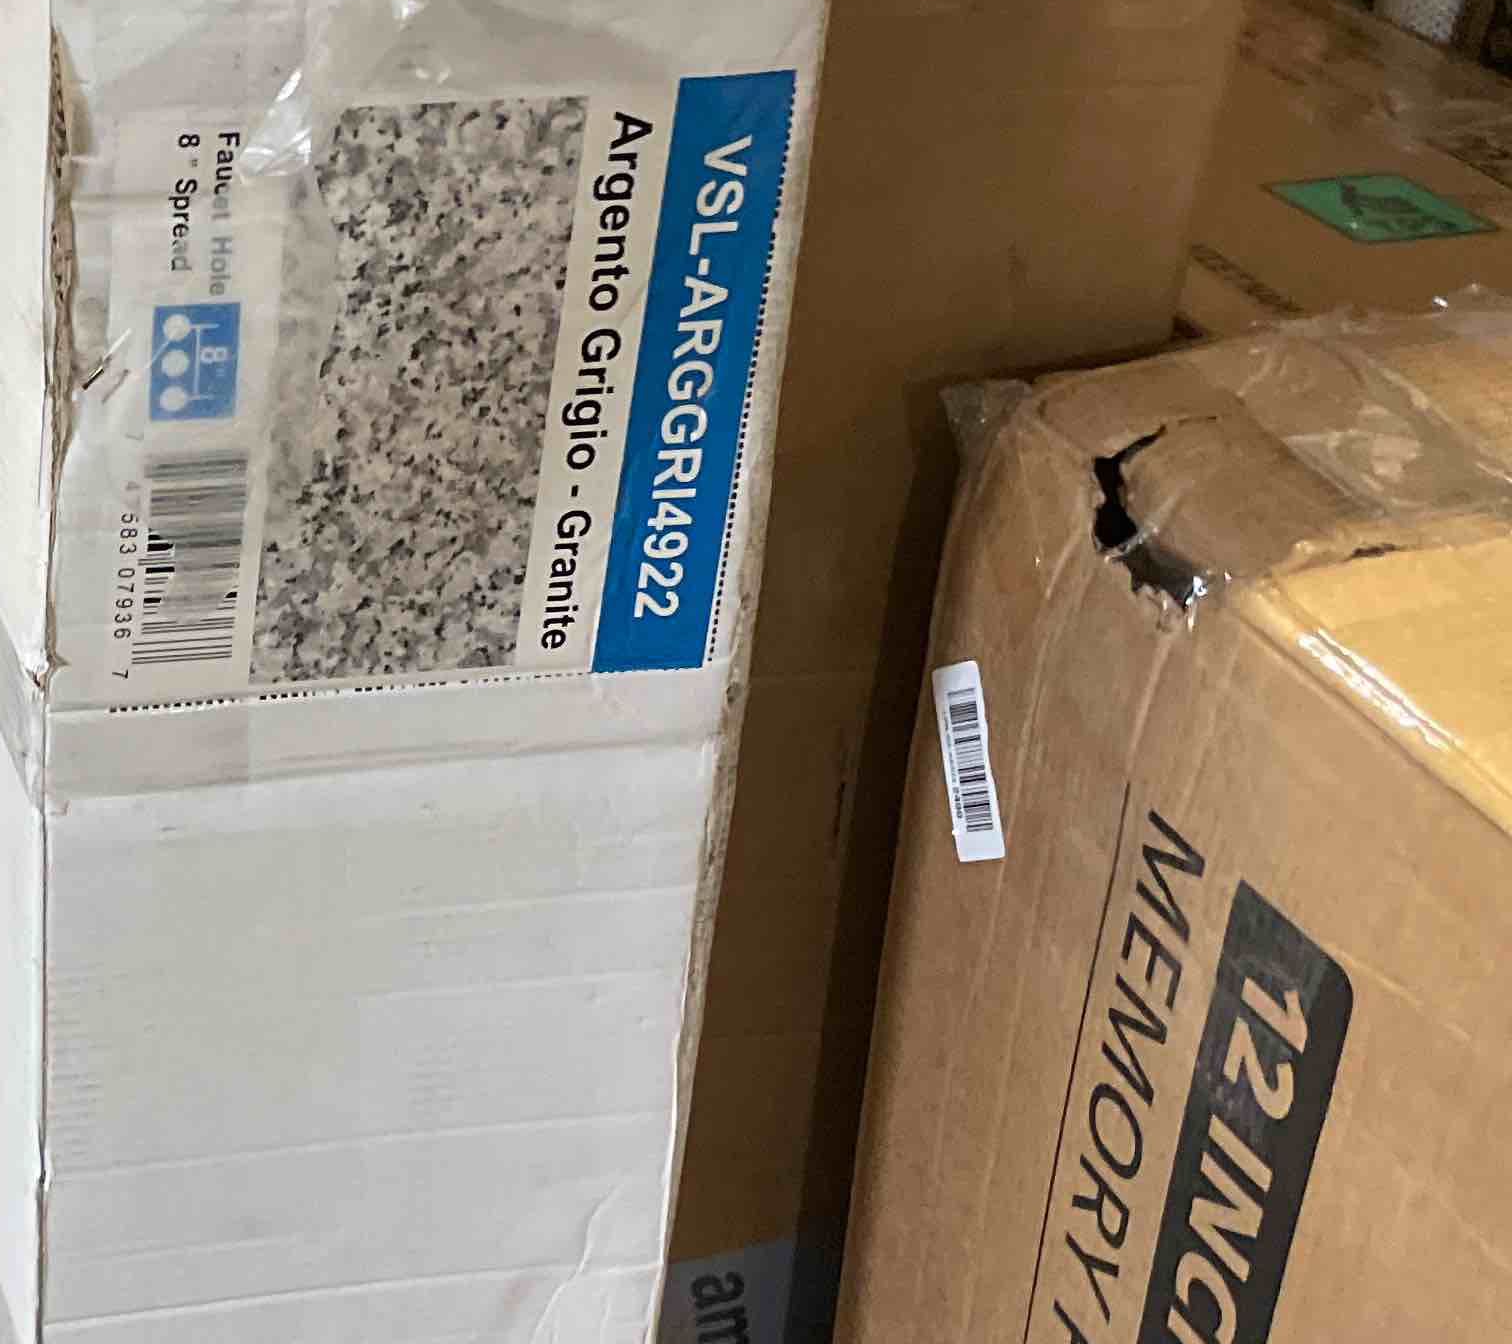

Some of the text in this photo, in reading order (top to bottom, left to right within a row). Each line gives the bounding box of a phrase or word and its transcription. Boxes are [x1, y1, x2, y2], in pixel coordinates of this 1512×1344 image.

[168, 178, 198, 273] Spread
[208, 235, 234, 296] Hole
[585, 112, 653, 312] Argento
[561, 328, 623, 472] Grigio
[632, 134, 753, 620] VSL-ARGGRI4922
[112, 567, 136, 640] 07936
[540, 509, 592, 651] Granite
[111, 669, 129, 680] 7
[1064, 809, 1206, 1324] MEMORY
[1222, 978, 1309, 1121] 12
